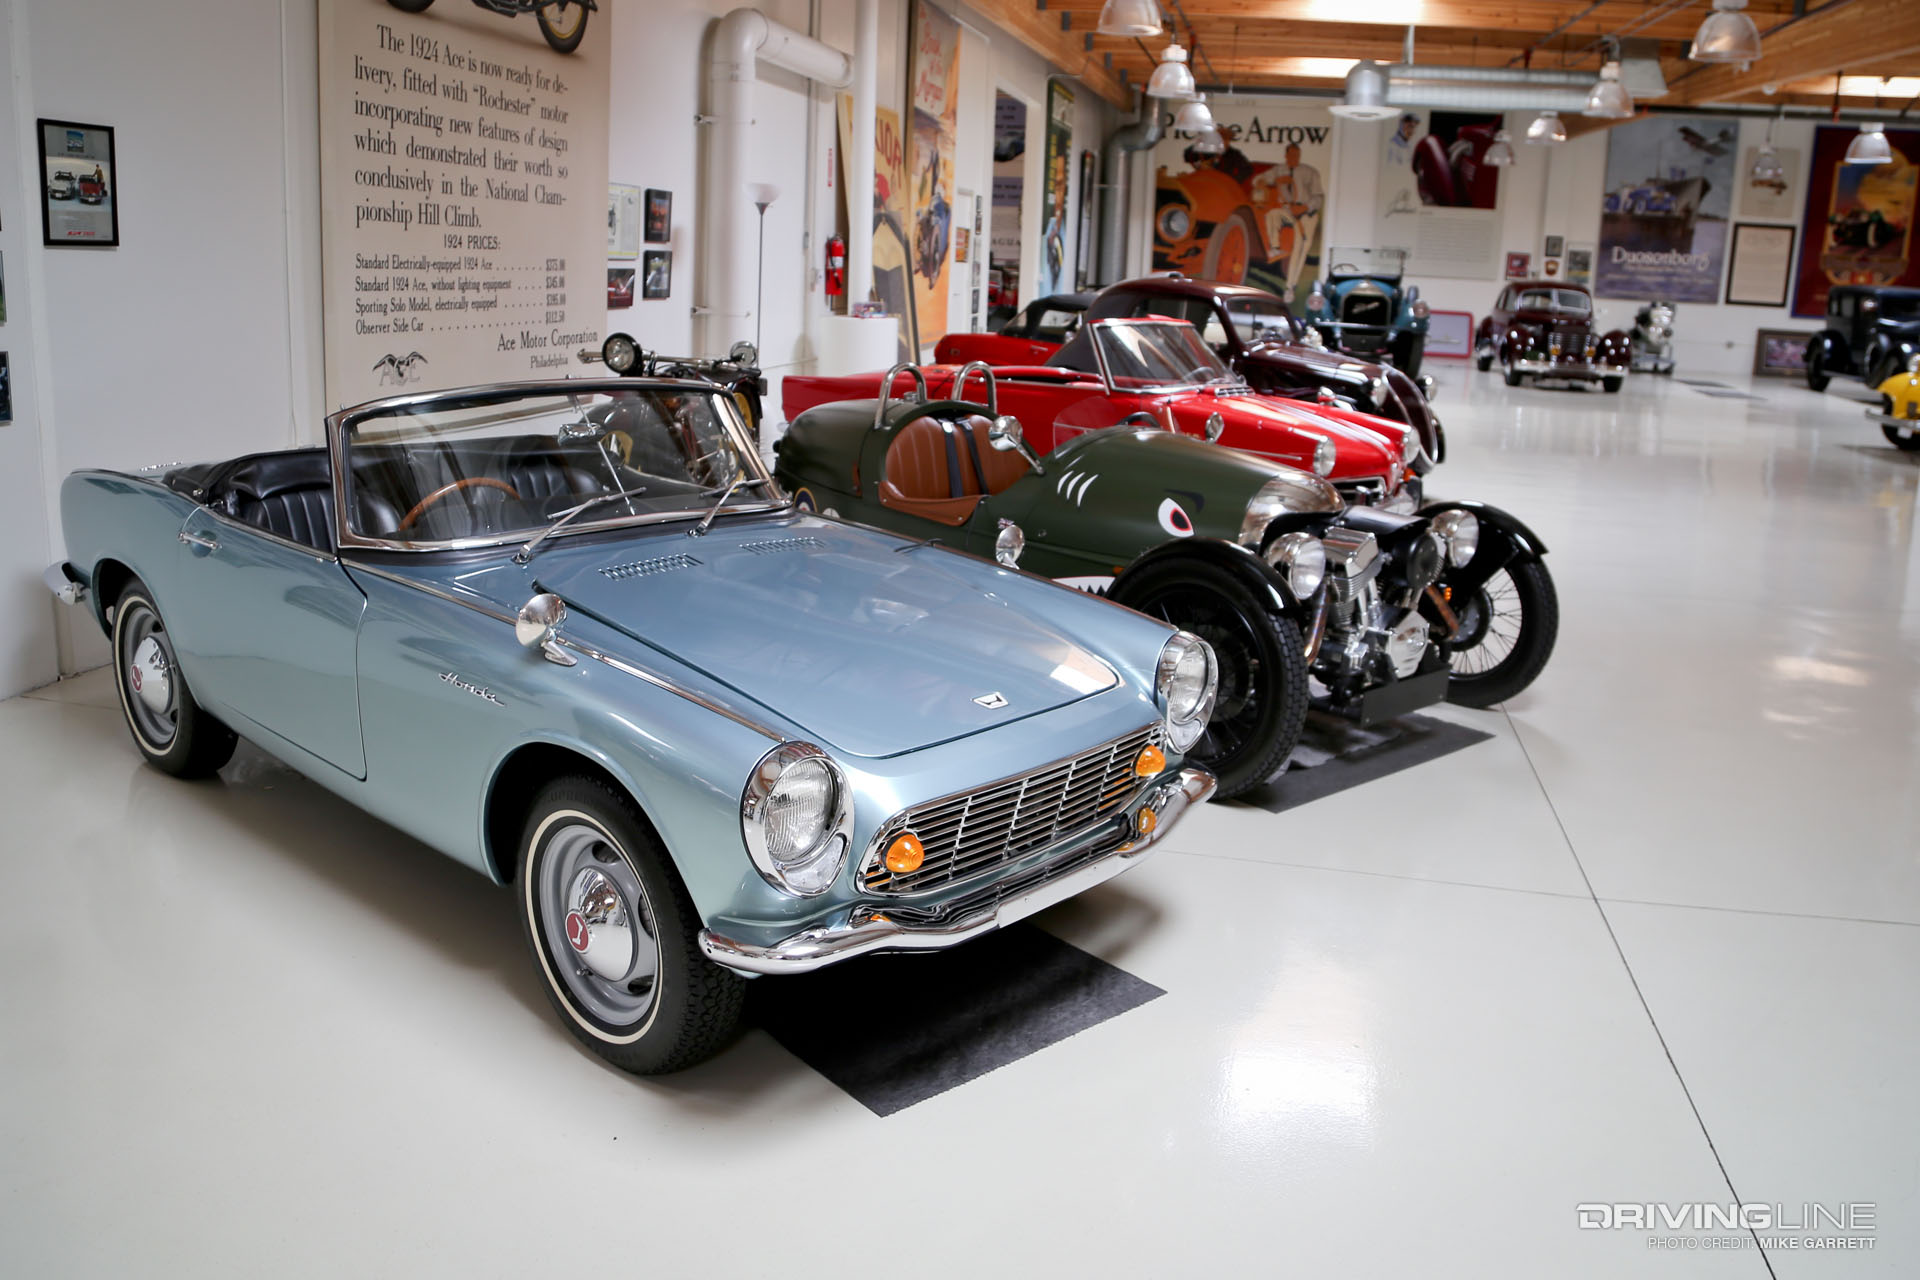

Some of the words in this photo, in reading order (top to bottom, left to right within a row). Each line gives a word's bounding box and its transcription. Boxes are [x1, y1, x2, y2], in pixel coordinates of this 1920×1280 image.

[376, 24, 405, 53] The
[410, 33, 439, 62] 1924
[443, 43, 465, 69] Ace
[468, 50, 477, 72] is
[480, 60, 502, 78] now
[506, 65, 533, 93] ready
[536, 69, 550, 91] for
[552, 73, 568, 94] de-
[354, 54, 396, 94] livery,
[403, 66, 437, 96] fitted
[442, 79, 468, 103] with
[541, 105, 568, 124] motor
[355, 91, 443, 137] incorporating
[449, 118, 472, 134] new
[478, 116, 520, 144] features
[524, 126, 536, 146] of
[539, 128, 568, 157] design
[1244, 116, 1330, 145] Arrow
[354, 128, 396, 155] which
[406, 136, 486, 168] demonstrated
[494, 149, 518, 172] their
[524, 157, 552, 177] worth
[557, 165, 568, 178] so
[355, 165, 433, 200] conclusively
[441, 173, 453, 195] in
[460, 175, 478, 198] the
[486, 178, 528, 202] National
[535, 184, 567, 205] Cham-
[356, 198, 413, 231] pionship
[418, 202, 440, 225] Hill
[444, 204, 482, 228] Climb.
[444, 233, 462, 249] 1924
[467, 235, 501, 250] PRICES:
[356, 252, 389, 270] Standard
[392, 254, 461, 273] Electrically-equipped
[464, 256, 478, 270] 1924
[481, 258, 493, 270] Ace
[355, 275, 389, 292] Standard
[392, 276, 409, 291] 1924
[412, 277, 428, 292] Ace,
[431, 277, 455, 291] without
[458, 276, 480, 293] lighting
[482, 278, 511, 293] equipment
[355, 298, 388, 316] Sporting
[390, 297, 406, 312] Solo
[409, 297, 432, 312] Model,
[435, 295, 469, 313] electrically
[471, 295, 497, 311] equipped
[355, 318, 390, 335] Observer
[392, 318, 408, 333] Side
[411, 316, 424, 332] Car
[497, 333, 516, 351] Ace
[520, 330, 547, 349] Motor
[551, 327, 598, 349] Corporation
[530, 353, 568, 368] Philadelphia
[439, 672, 505, 706] Honda
